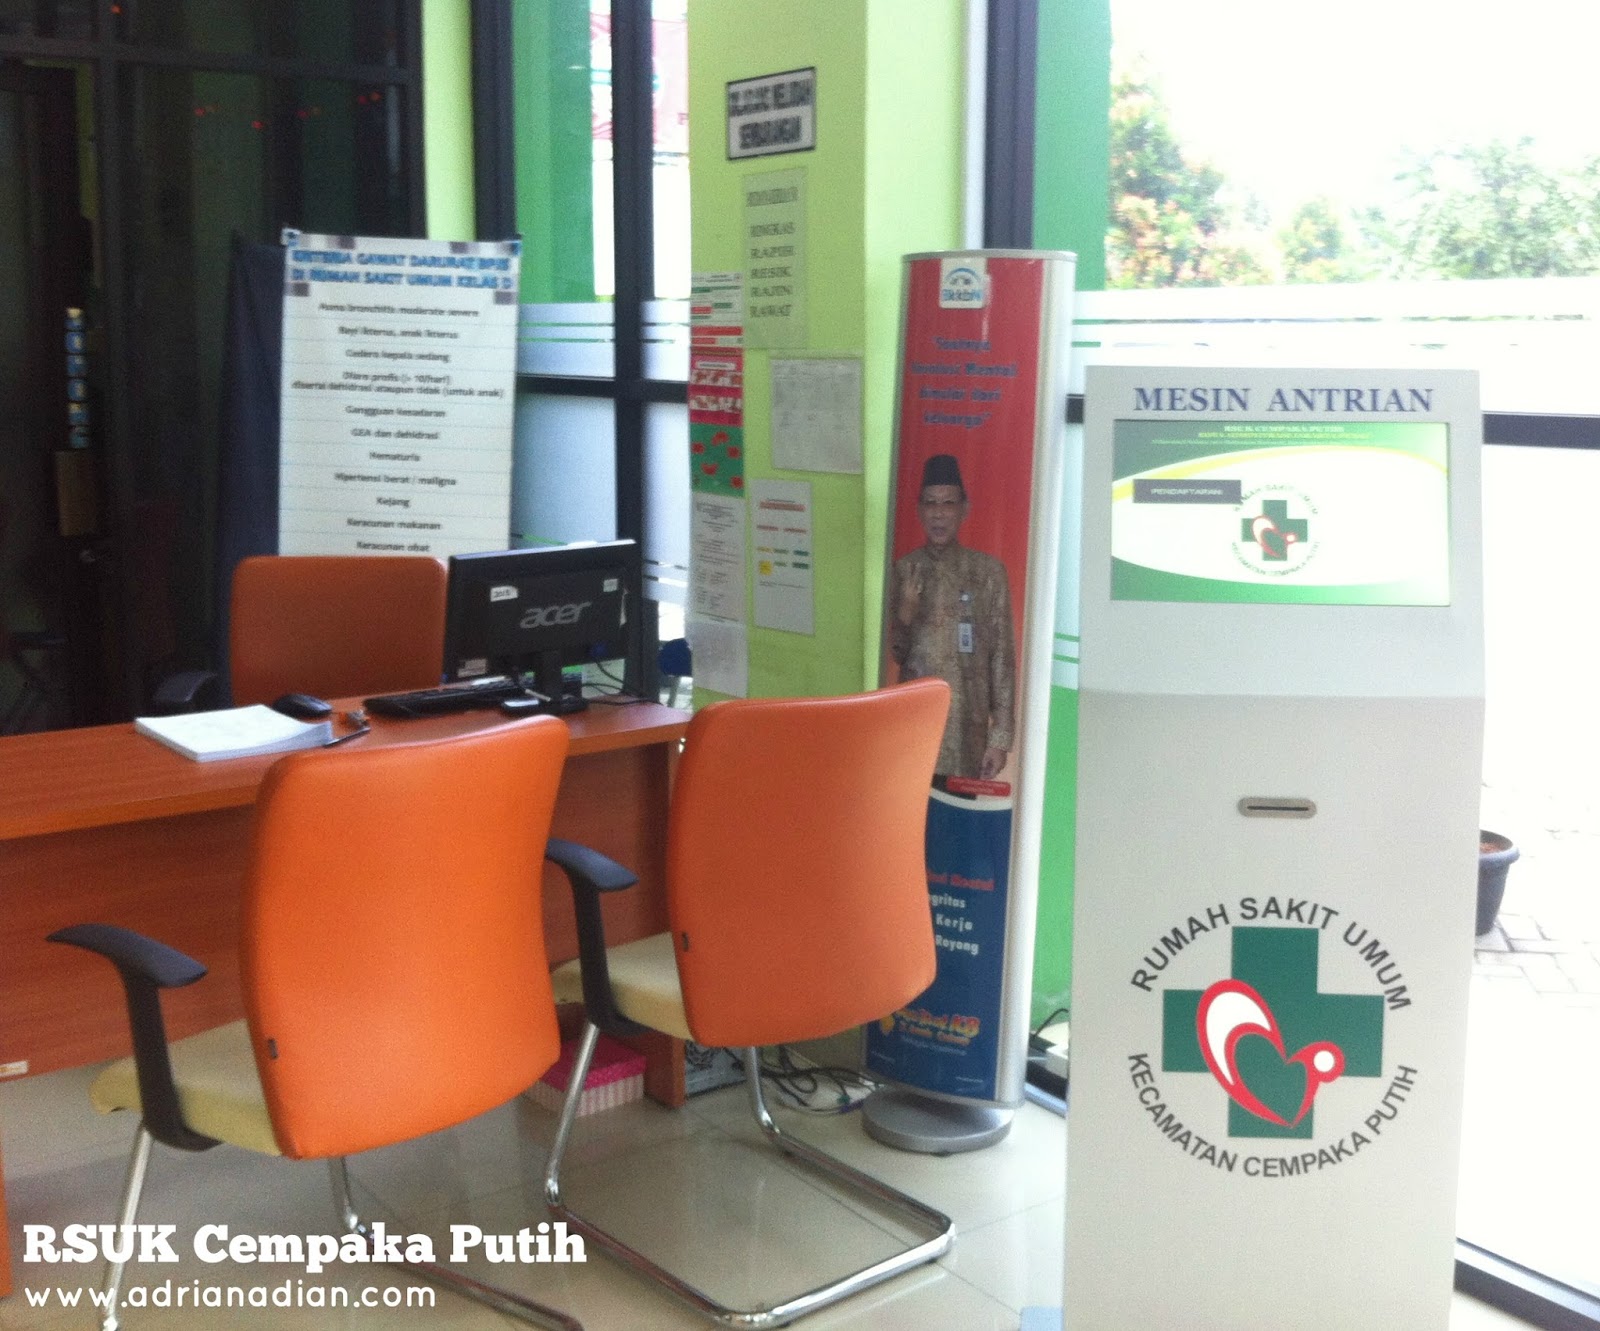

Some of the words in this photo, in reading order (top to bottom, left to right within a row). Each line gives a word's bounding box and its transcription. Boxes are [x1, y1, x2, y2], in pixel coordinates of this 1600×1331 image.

[1133, 387, 1249, 412] MESIN
[1266, 388, 1434, 412] ANTRIAN
[376, 497, 410, 508] Kejang
[1151, 487, 1224, 496] PENDAFTARAN
[520, 601, 591, 629] acer
[936, 912, 973, 933] Kerja
[935, 934, 980, 957] Royong
[1130, 903, 1230, 992] RUMAH
[1239, 896, 1339, 931] SAKIT
[1342, 921, 1412, 1011] UMUM
[1128, 1052, 1238, 1173] KECAMATAN
[1243, 1131, 1371, 1178] CEMPAKA
[1364, 1064, 1418, 1136] PUTIH
